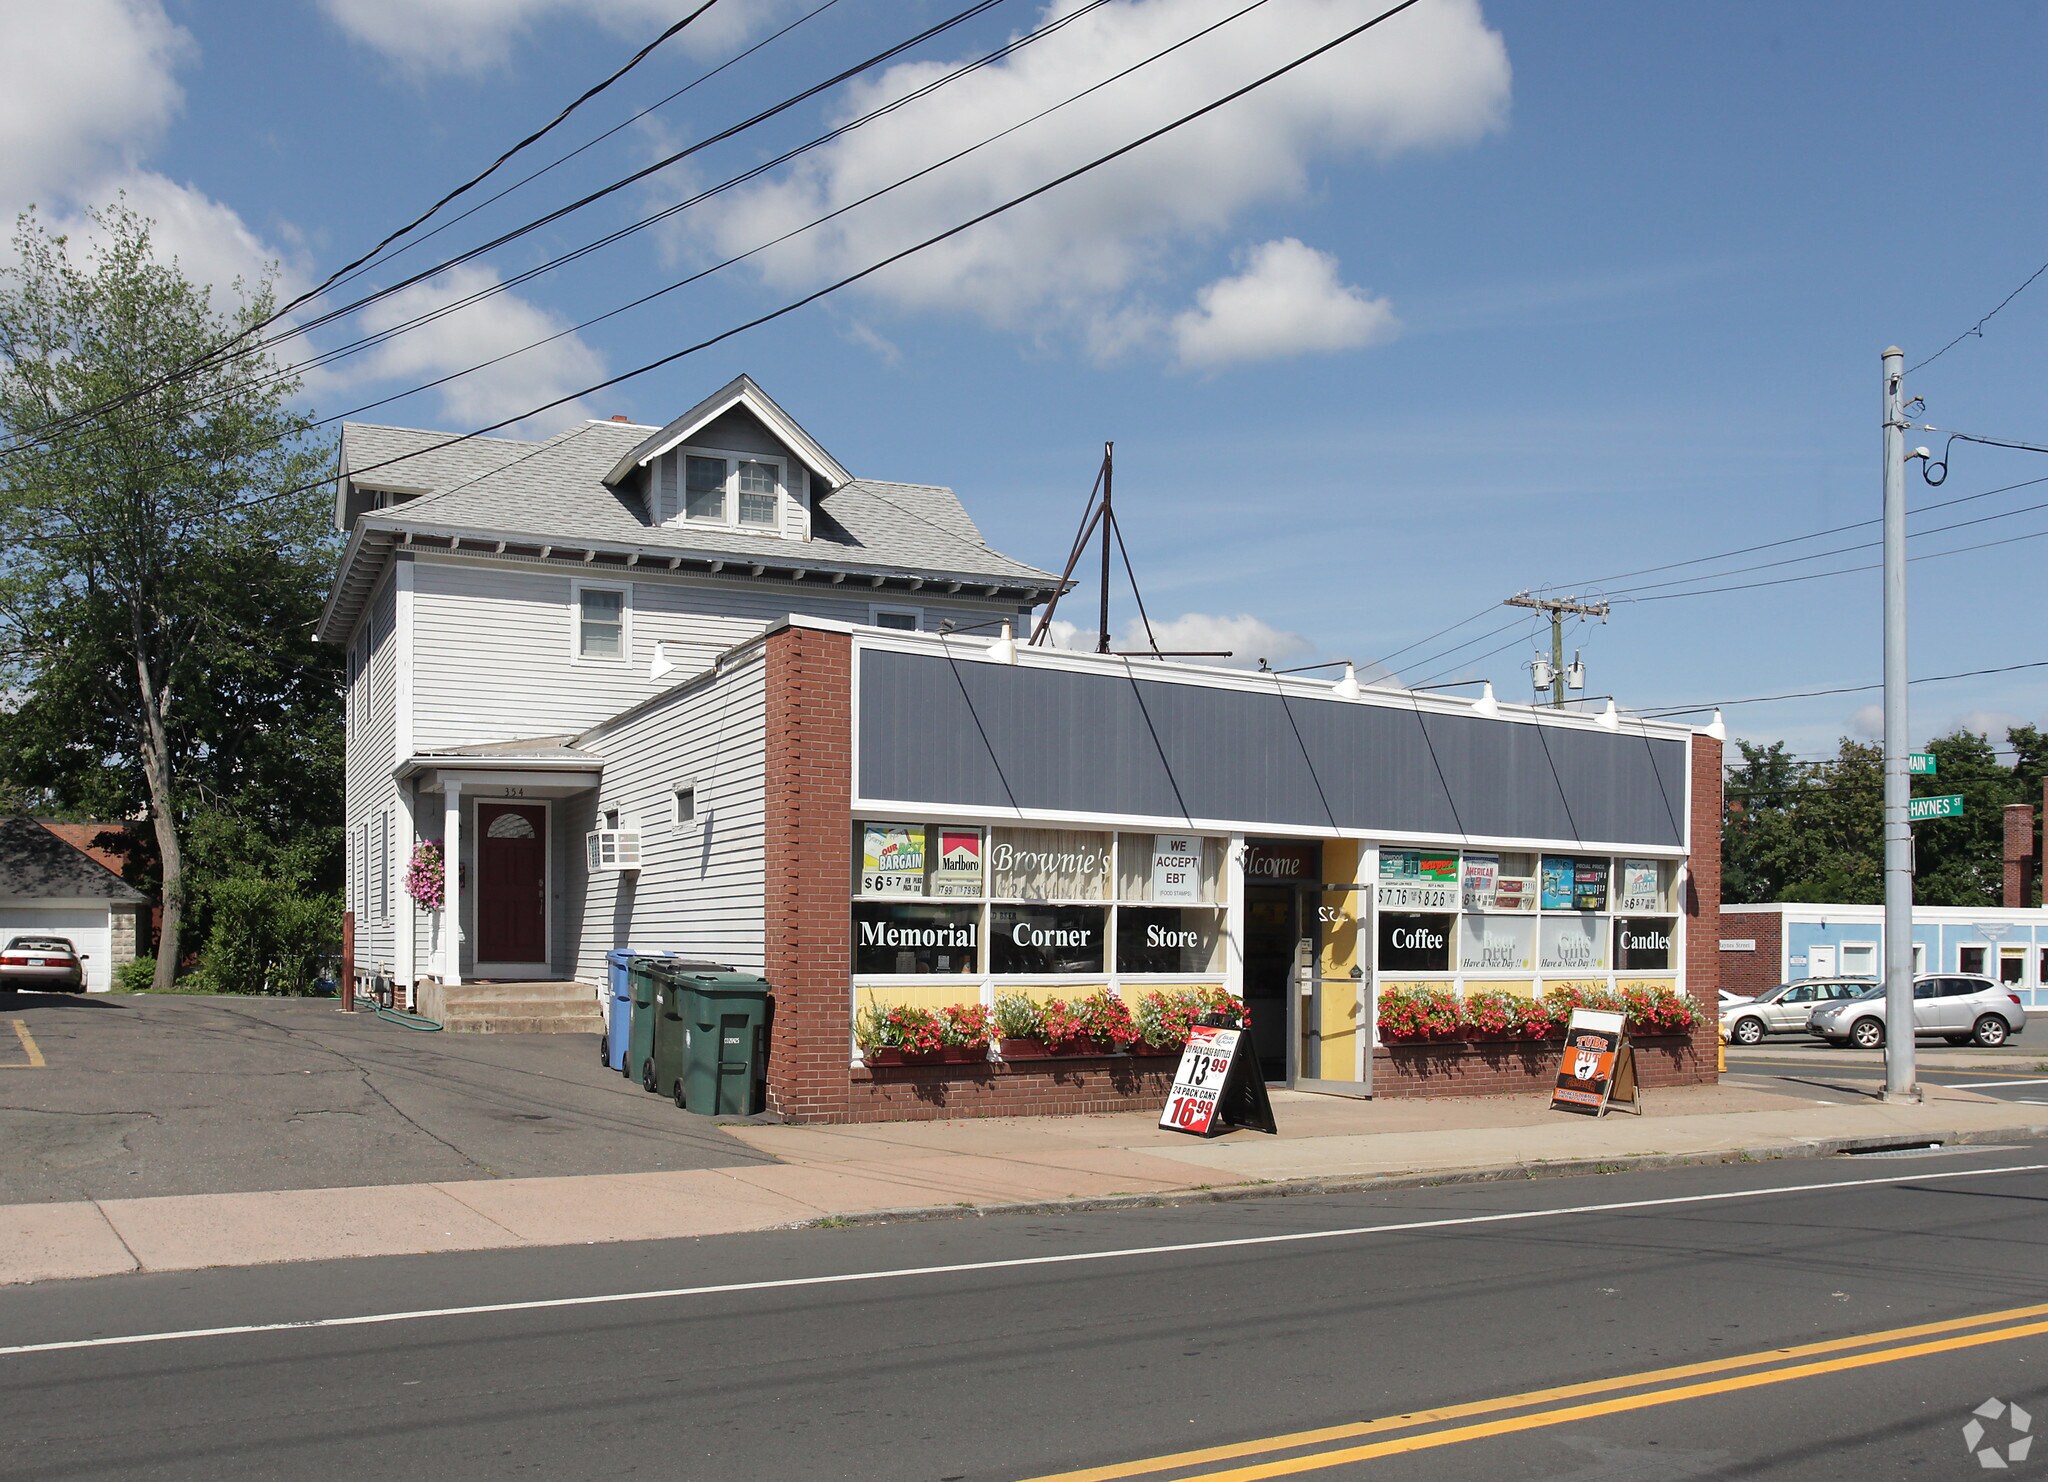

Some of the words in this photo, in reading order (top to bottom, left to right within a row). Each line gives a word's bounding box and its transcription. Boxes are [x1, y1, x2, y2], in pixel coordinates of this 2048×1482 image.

[1929, 757, 1934, 765] ST
[504, 787, 523, 797] 354
[1910, 799, 1950, 816] HAYNES
[1954, 797, 1961, 806] ST
[882, 843, 898, 855] OUR
[1171, 840, 1187, 851] WE
[879, 853, 923, 871] BARGAIN
[943, 855, 979, 870] Marlboro
[992, 843, 1110, 874] Brownie's
[1156, 857, 1197, 868] ACCEPT
[1244, 847, 1300, 875] elcome
[1166, 873, 1186, 884] EBT
[860, 921, 976, 948] Memorial
[1012, 922, 1091, 948] Corner
[1146, 924, 1198, 948] Store
[1392, 927, 1443, 949] Coffee
[1620, 931, 1671, 950] Candles
[1463, 959, 1480, 968] Have
[1487, 958, 1500, 968] Nice
[1501, 959, 1514, 969] Day
[1541, 959, 1555, 968] Have
[1563, 958, 1576, 968] Nice
[1577, 959, 1589, 969] Day
[1577, 1036, 1608, 1048] TUBE
[1576, 1050, 1600, 1063] CUT
[1172, 1086, 1181, 1095] 24
[1181, 1086, 1198, 1097] PACK
[1199, 1090, 1217, 1101] CANS
